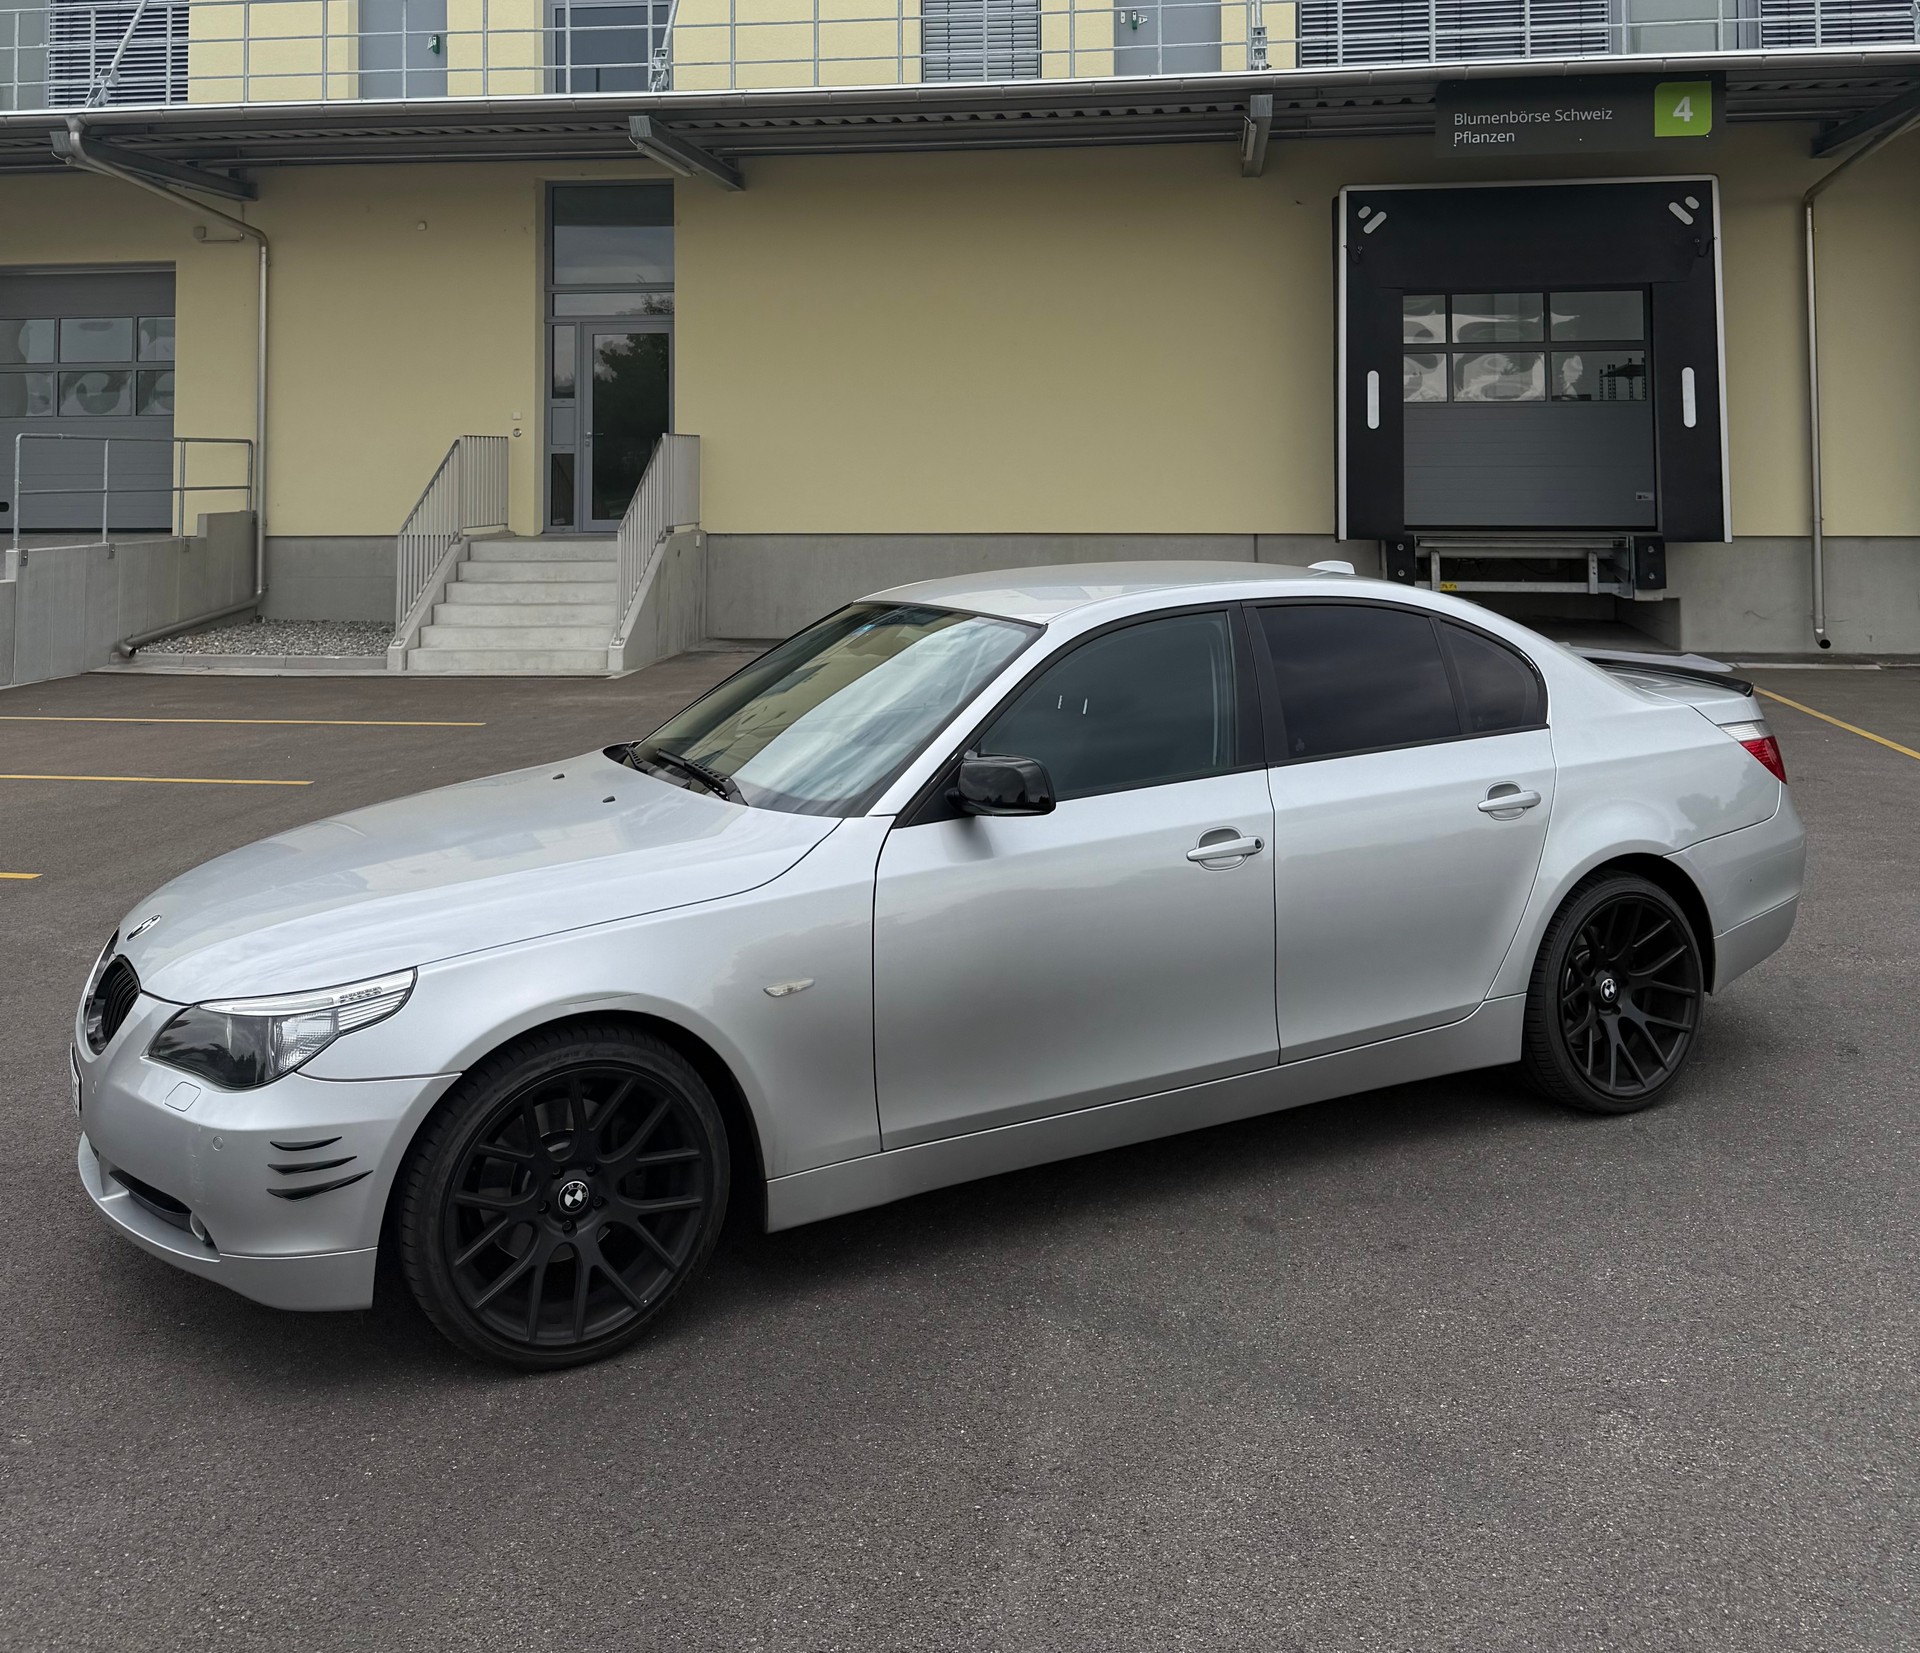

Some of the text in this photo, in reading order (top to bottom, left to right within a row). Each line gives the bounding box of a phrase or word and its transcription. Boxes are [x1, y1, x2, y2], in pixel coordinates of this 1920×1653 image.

[1454, 108, 1613, 126] Blumenbörse Schweiz
[1672, 96, 1693, 122] 4
[1454, 131, 1515, 144] Pflanzen
